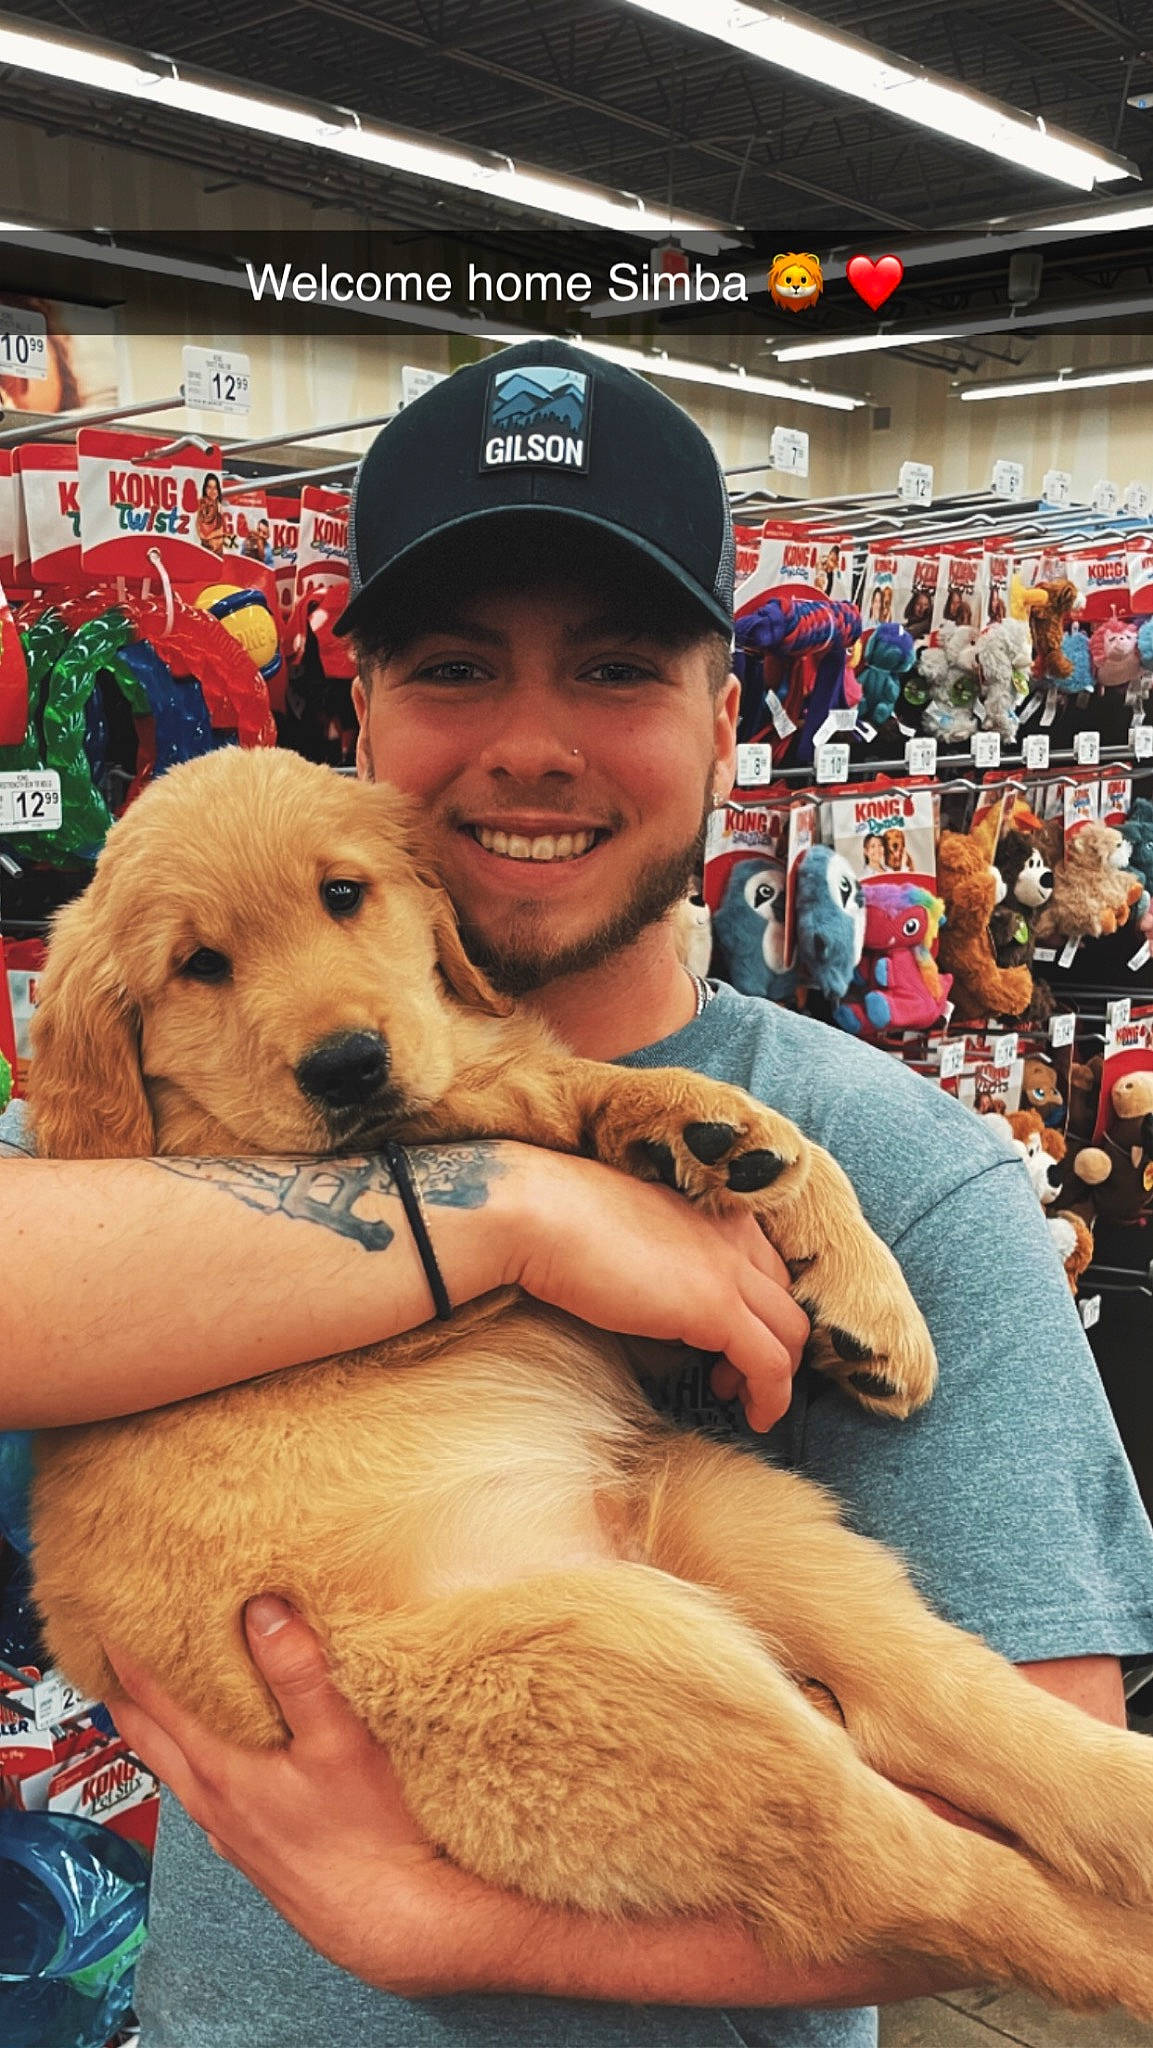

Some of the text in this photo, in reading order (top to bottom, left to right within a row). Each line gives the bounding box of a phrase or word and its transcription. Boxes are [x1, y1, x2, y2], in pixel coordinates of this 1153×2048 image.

[485, 434, 585, 467] GILSON
[109, 471, 178, 511] KONG
[114, 503, 191, 535] Twistz
[1088, 561, 1122, 579] KONG
[725, 809, 768, 833] KONG
[855, 799, 900, 823] KONG
[0, 1720, 29, 1737] LER
[82, 1761, 136, 1808] KONG
